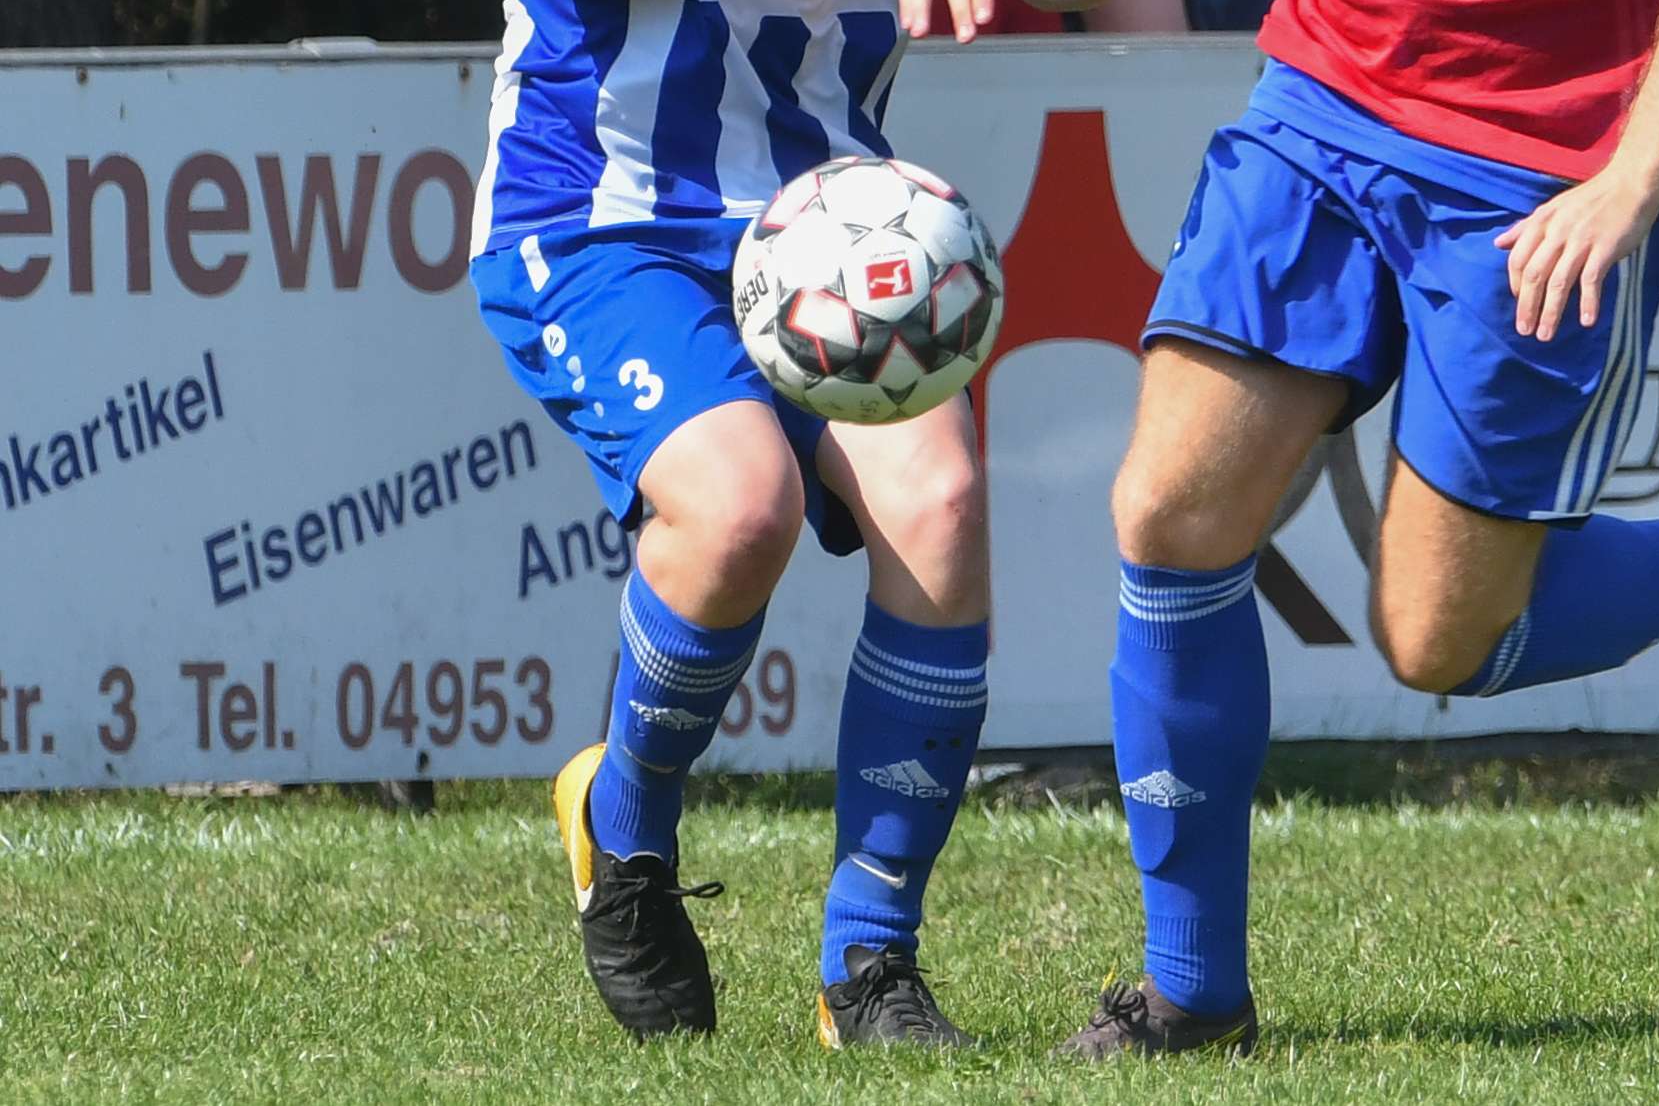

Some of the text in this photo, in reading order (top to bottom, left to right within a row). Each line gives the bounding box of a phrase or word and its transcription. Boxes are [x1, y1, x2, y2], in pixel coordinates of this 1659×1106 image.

[618, 358, 664, 411] 3
[205, 418, 538, 607] Eisenwaren
[98, 664, 136, 755] 3
[180, 661, 294, 752] Tel.
[335, 656, 553, 747] 04953
[1120, 782, 1207, 808] adidas
